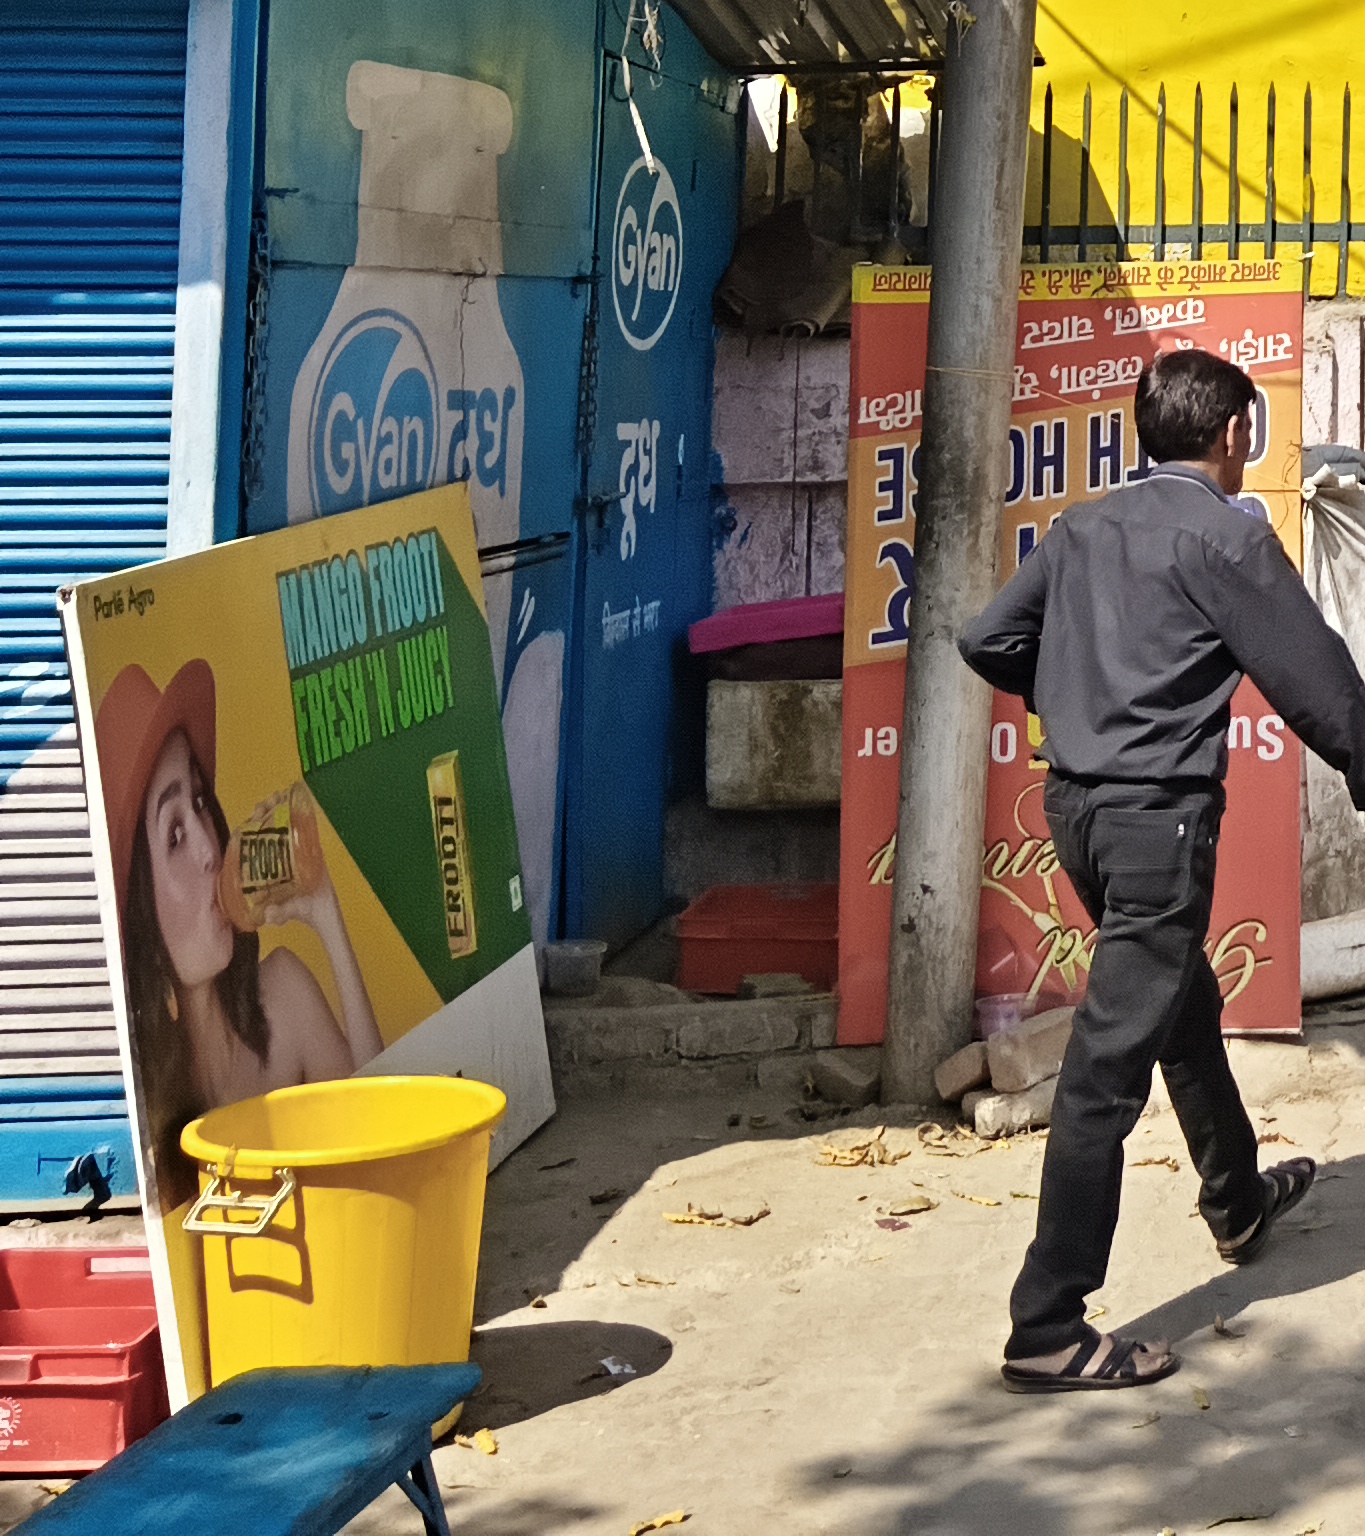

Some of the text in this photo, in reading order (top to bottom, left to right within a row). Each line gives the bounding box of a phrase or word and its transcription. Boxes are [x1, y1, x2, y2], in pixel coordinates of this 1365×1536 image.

[617, 206, 675, 322] Gyan
[1155, 265, 1175, 291] के
[1177, 263, 1226, 292] मार्केट
[1229, 262, 1283, 283] अनवर
[1020, 315, 1095, 349] चादर
[1050, 363, 1142, 401] लहंगा,
[616, 420, 661, 560] दूध
[875, 420, 1067, 526] HOE
[128, 586, 155, 617] Agro
[279, 531, 445, 669] MANGO FROOTI
[292, 656, 372, 773] FRESH
[397, 625, 454, 730] JUICY
[438, 796, 465, 938] FROOTI
